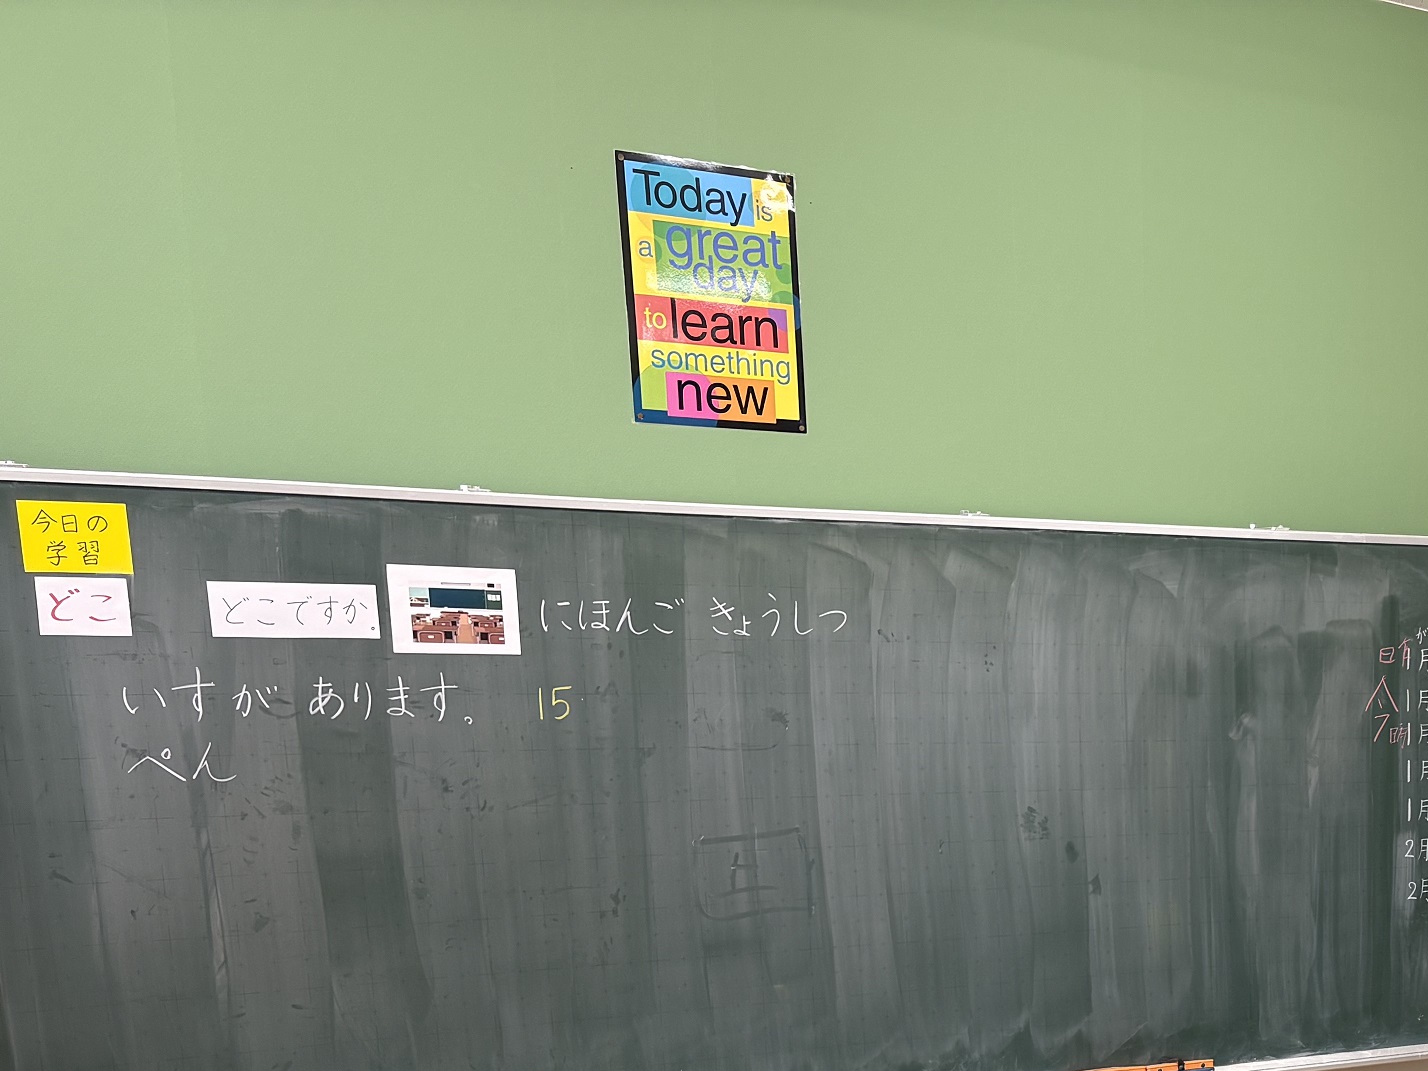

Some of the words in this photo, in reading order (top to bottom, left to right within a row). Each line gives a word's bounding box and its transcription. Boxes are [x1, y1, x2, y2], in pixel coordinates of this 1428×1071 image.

[632, 168, 747, 226] Today
[755, 200, 773, 222] is
[638, 239, 654, 258] a
[665, 224, 782, 271] great
[692, 255, 759, 304] day
[643, 306, 668, 330] to
[670, 297, 779, 349] learn
[651, 349, 791, 385] something
[677, 379, 769, 416] new
[31, 509, 109, 534] 今日の
[45, 540, 101, 566] 学習
[49, 588, 117, 622] どこ
[222, 595, 378, 632] どこですか。
[540, 598, 685, 636] にほんご
[709, 592, 848, 637] きょうしつ
[537, 685, 573, 721] 15
[127, 742, 237, 783] ぺん
